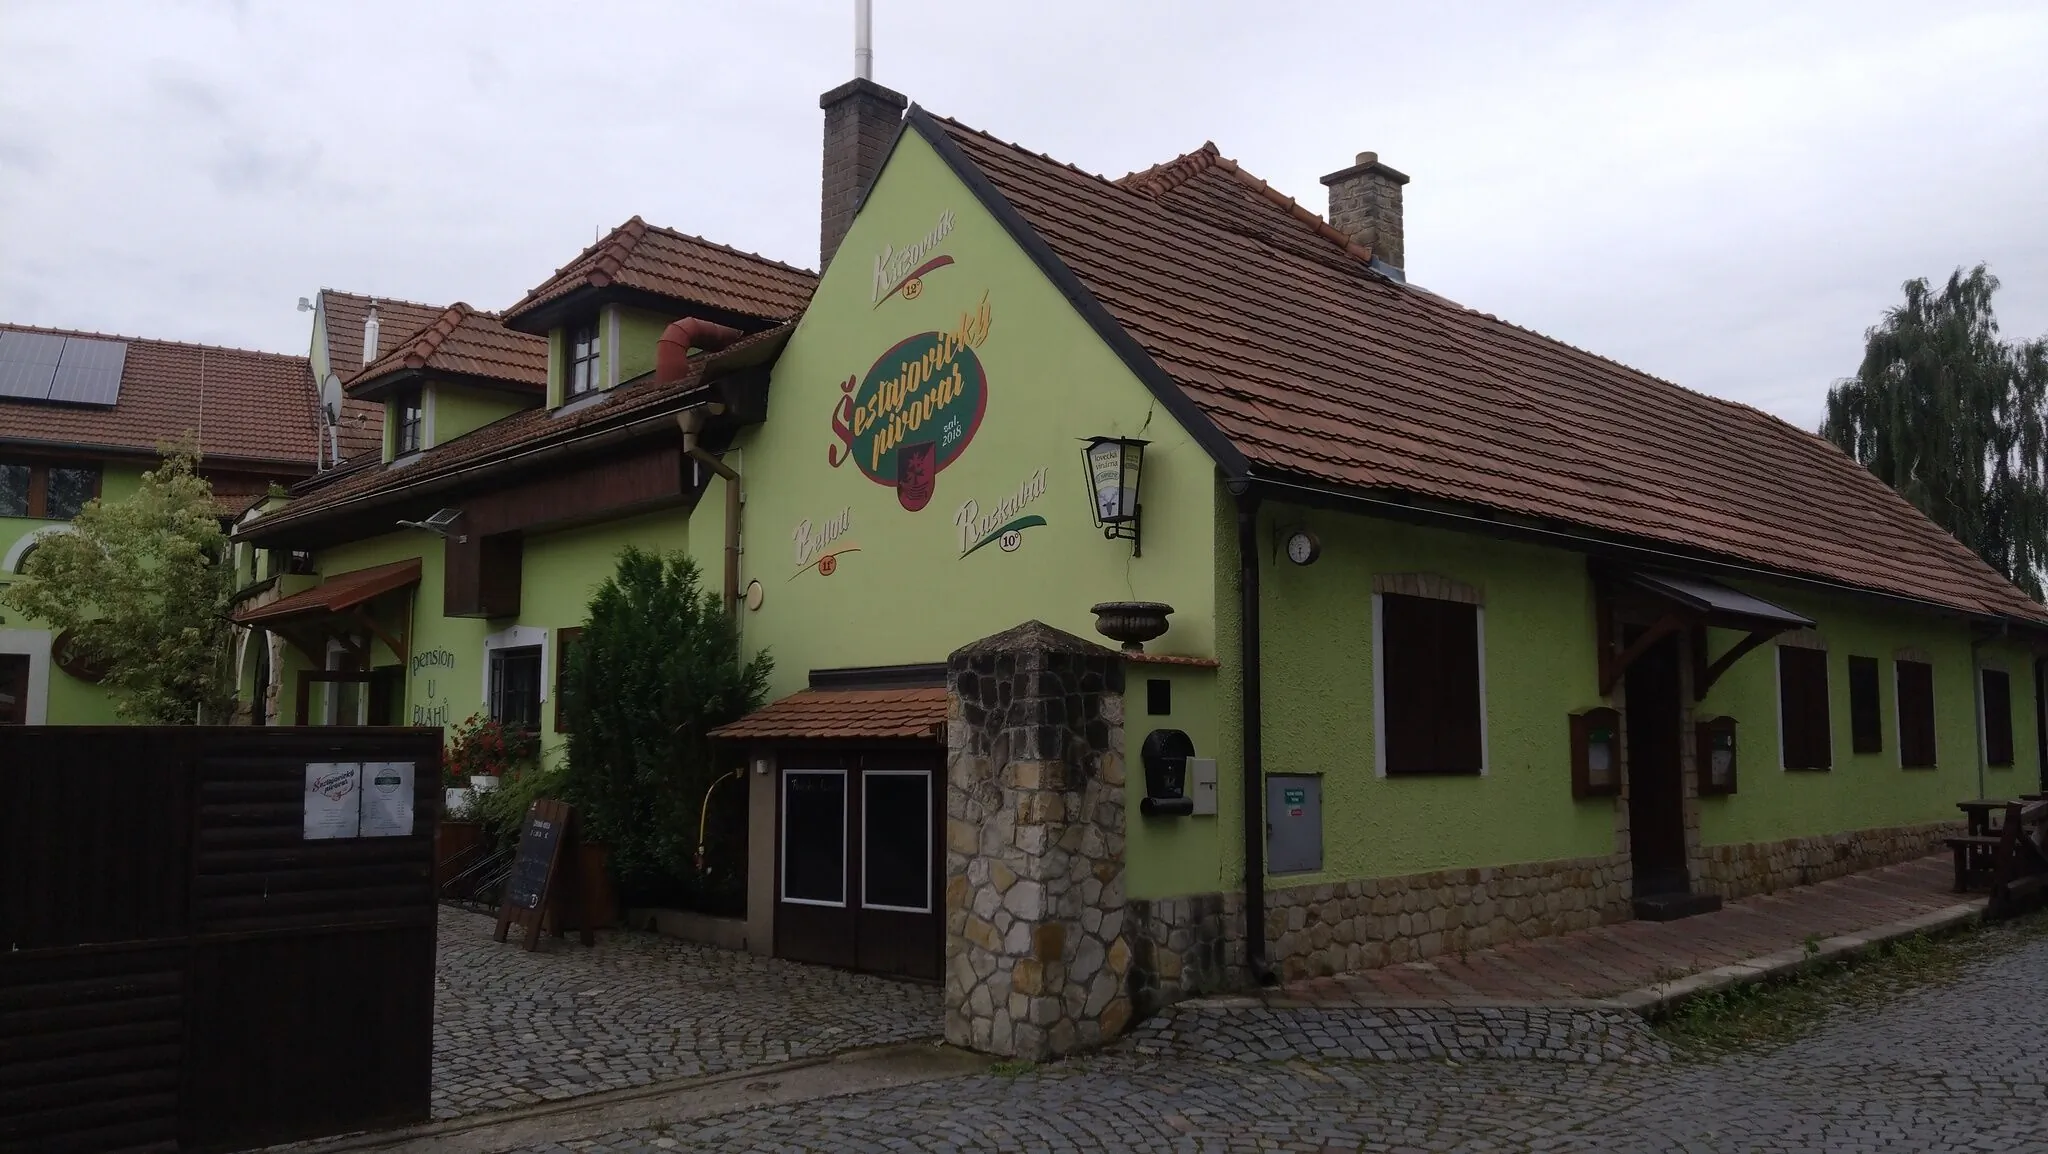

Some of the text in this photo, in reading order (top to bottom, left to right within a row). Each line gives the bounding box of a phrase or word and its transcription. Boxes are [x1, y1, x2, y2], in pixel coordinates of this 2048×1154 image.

[828, 288, 993, 468] Šestajovický
[872, 362, 965, 472] pivovar
[942, 425, 962, 447] 2018
[412, 644, 455, 676] pension
[428, 679, 436, 699] U
